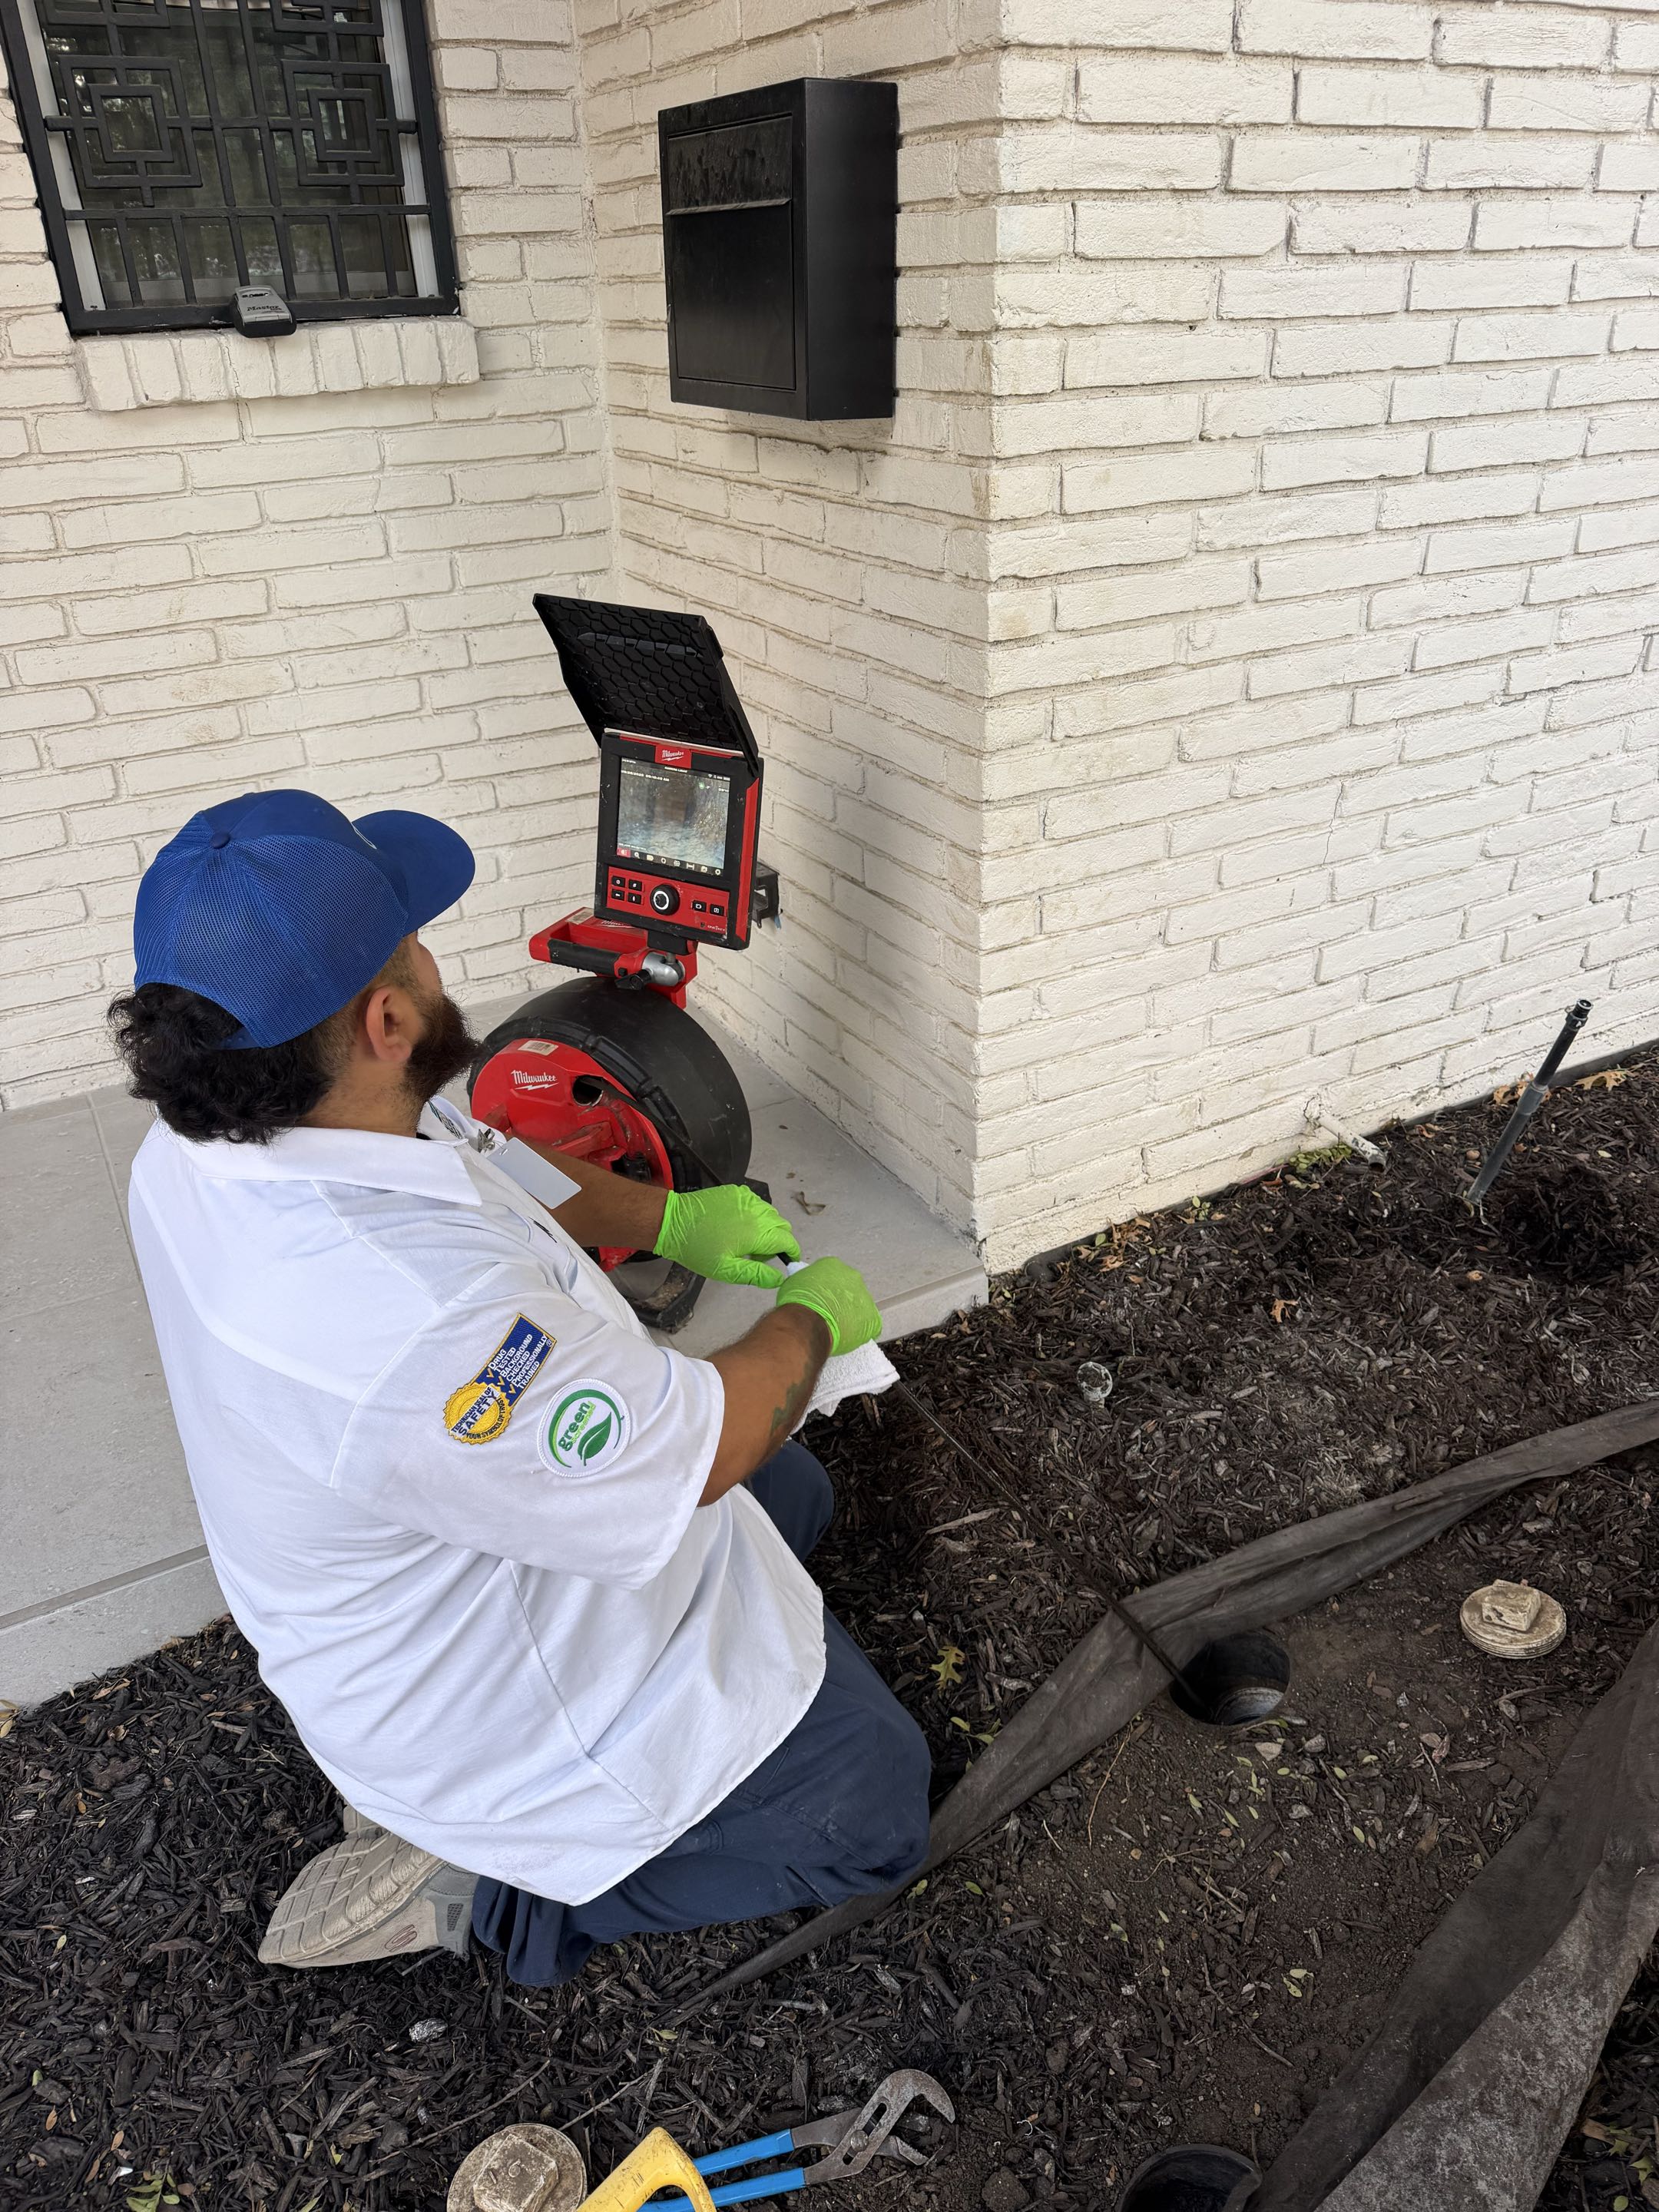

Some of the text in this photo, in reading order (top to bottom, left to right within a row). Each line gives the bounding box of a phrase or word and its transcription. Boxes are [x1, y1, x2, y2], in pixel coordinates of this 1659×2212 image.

[510, 1069, 558, 1084] Milwaukee
[488, 1349, 507, 1369] DRUG
[493, 1347, 516, 1373] TESTED
[499, 1333, 533, 1378] BACKGROUND
[506, 1350, 530, 1382] CHECKED
[511, 1333, 548, 1388] PROFESSIONALLY
[517, 1361, 540, 1389] TRAINED
[451, 1386, 492, 1432] TECHNICIAN SEAL OF
[459, 1390, 497, 1435] SAFETY
[496, 1397, 506, 1413] TRUST
[497, 1414, 505, 1423] OF
[482, 1422, 501, 1438] SYMBOL
[558, 1402, 590, 1452] green
